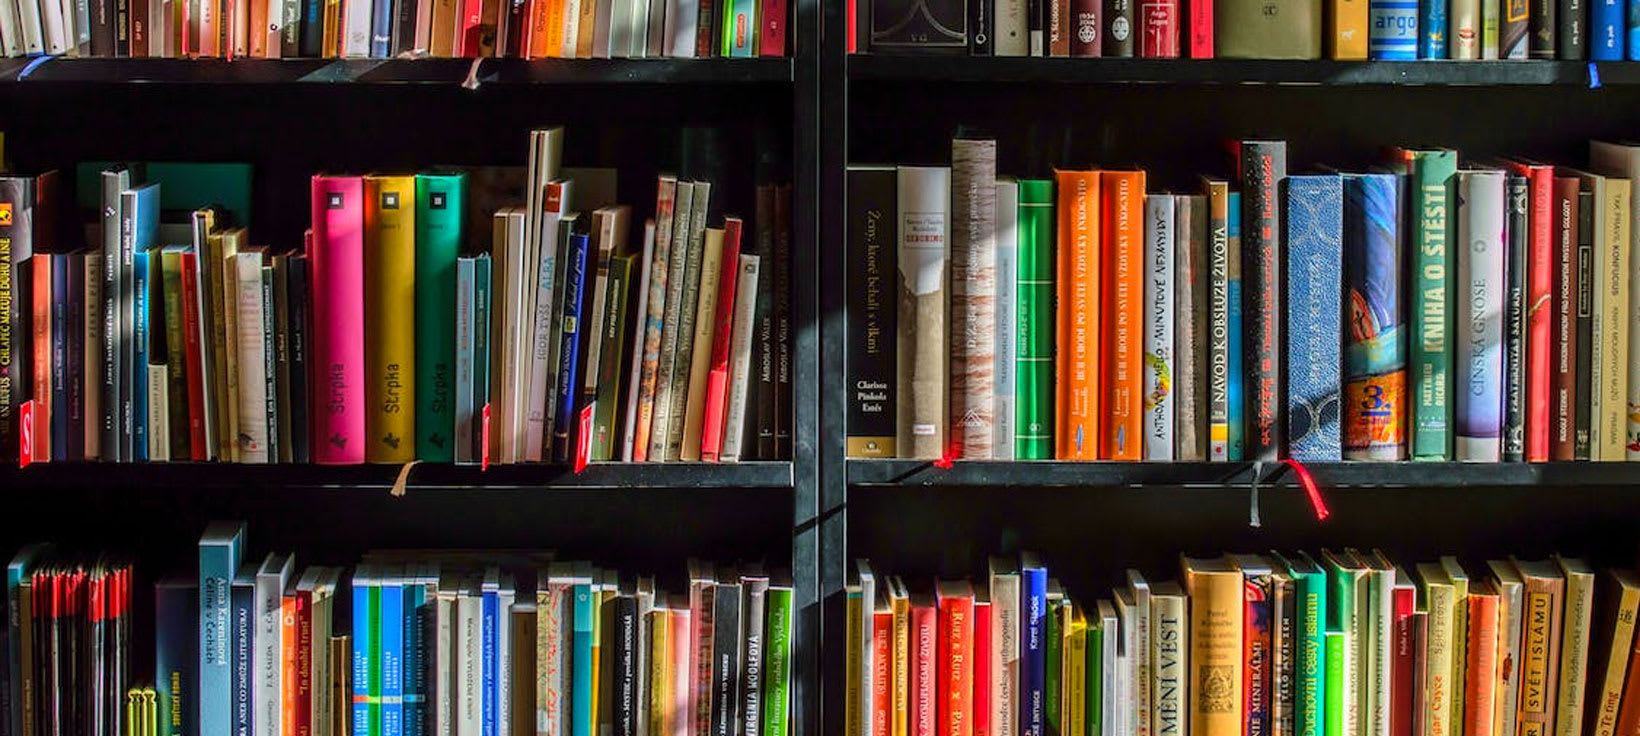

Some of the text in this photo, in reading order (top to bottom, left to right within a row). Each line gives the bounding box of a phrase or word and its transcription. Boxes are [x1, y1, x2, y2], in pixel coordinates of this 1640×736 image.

[1375, 13, 1417, 36] argo
[1077, 179, 1089, 231] INKOGNITO
[1119, 179, 1130, 231] INKOGNITO
[1155, 218, 1167, 276] NESMYSLY
[1420, 184, 1445, 353] KNIHA O ŠTĚSTÍ
[1611, 244, 1621, 296] KONFUCIUS
[1077, 312, 1087, 326] PO
[1119, 312, 1129, 326] PO
[1154, 279, 1166, 341] MINUTOVÉ
[1210, 227, 1226, 403] NÁVOD K OBSLUZE ŽIVOTA
[1473, 278, 1485, 334] GNOSE
[0, 326, 9, 366] CHLAPEC
[867, 322, 880, 355] vlkmi
[761, 342, 771, 382] MIROSLAV
[779, 343, 789, 383] MIROSLAV
[1030, 627, 1038, 650] Karel
[1304, 641, 1319, 675] cesty
[300, 645, 309, 678] double
[1251, 640, 1262, 713] MINERÁLMI
[1302, 677, 1318, 736] Duchovní
[1431, 675, 1442, 711] Cayce
[1526, 670, 1541, 707] SVĚT
[746, 692, 757, 736] VIRGINIA
